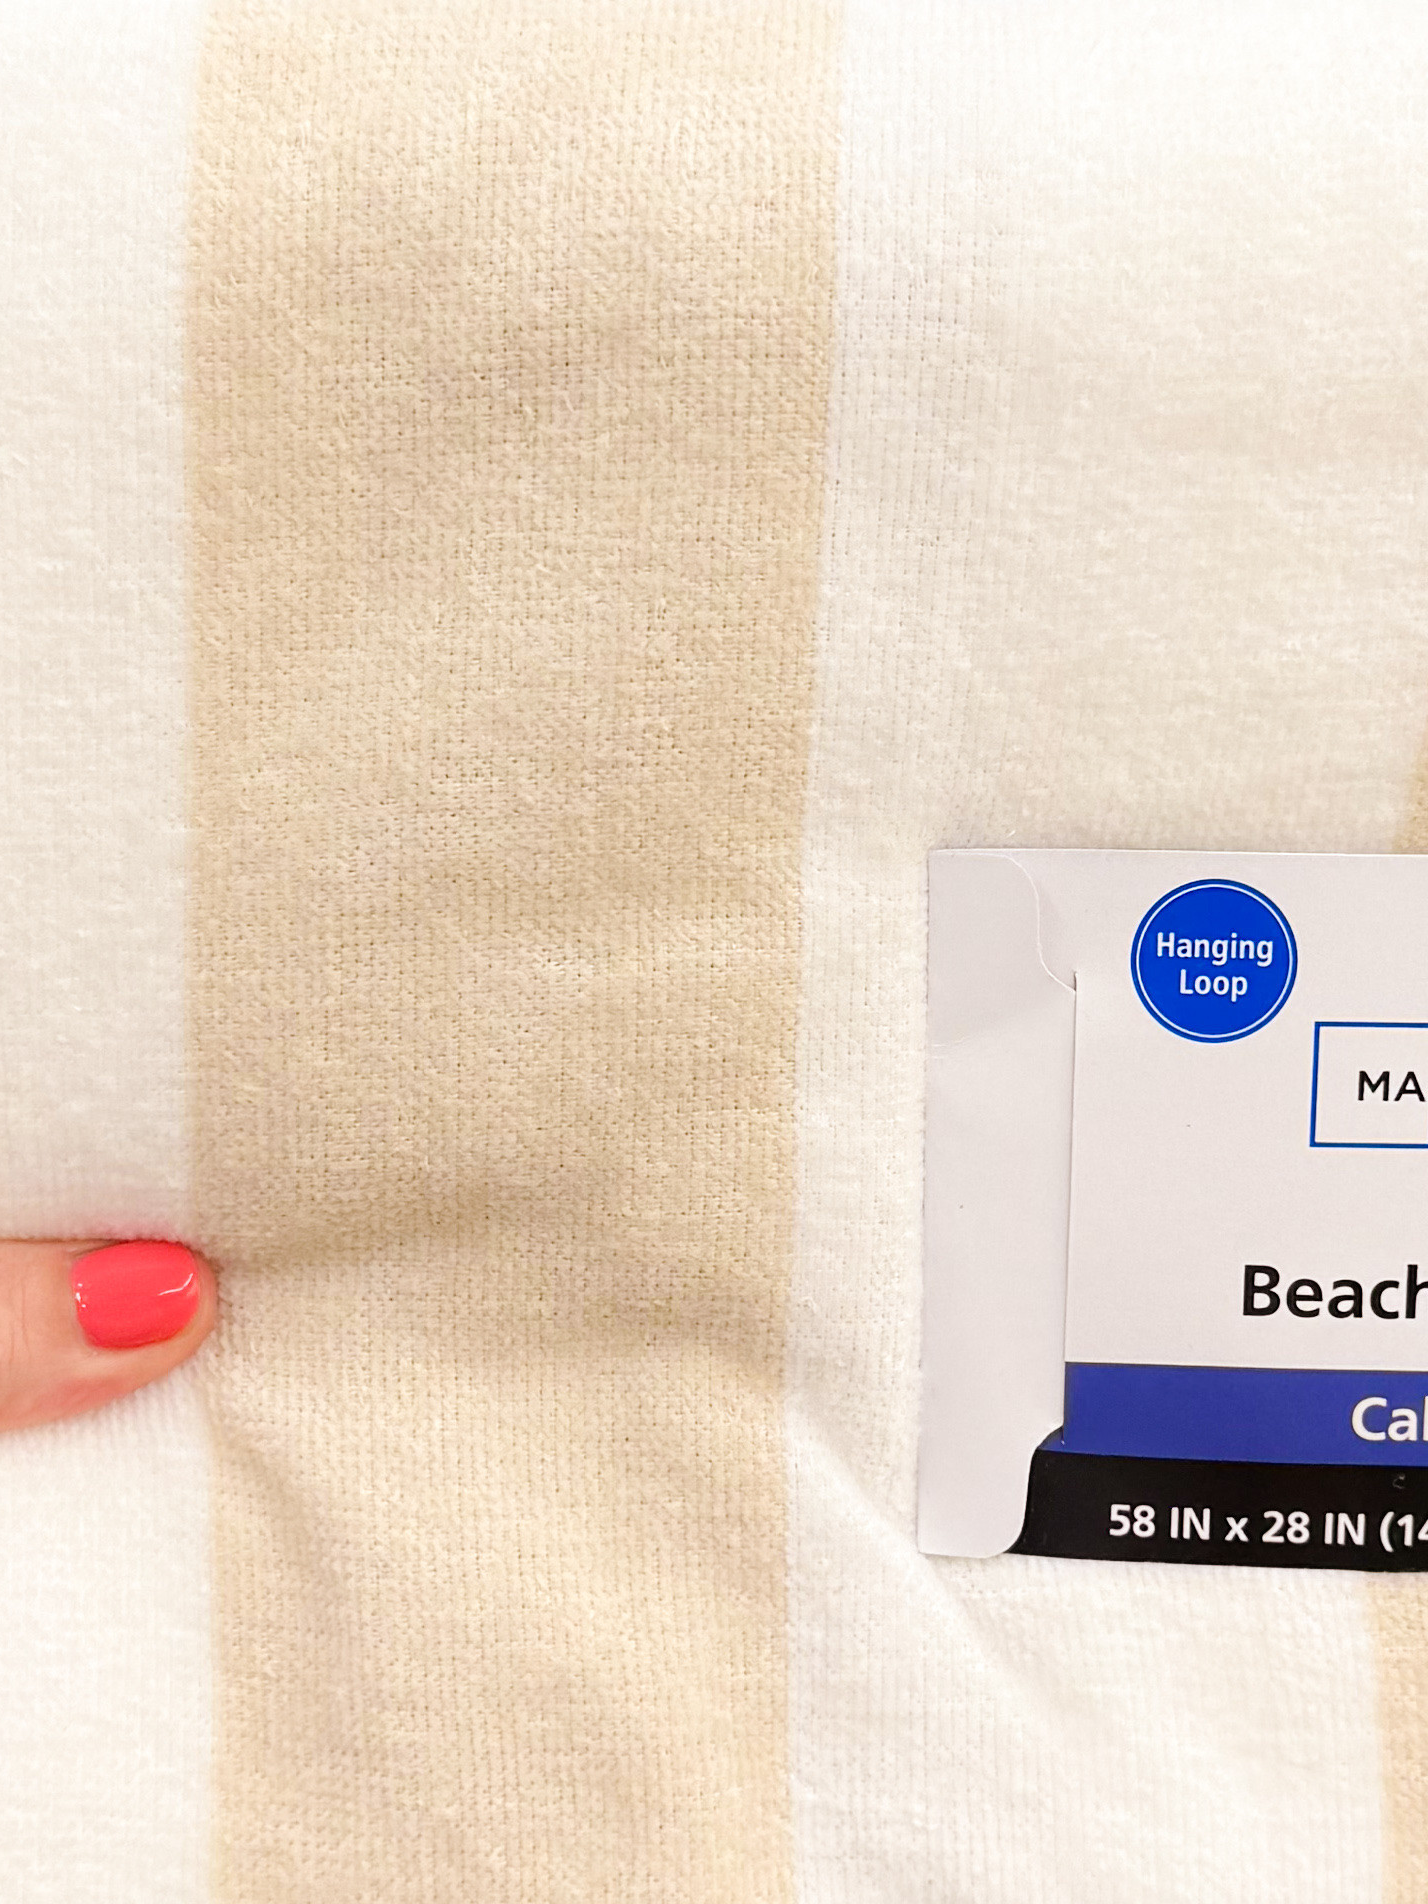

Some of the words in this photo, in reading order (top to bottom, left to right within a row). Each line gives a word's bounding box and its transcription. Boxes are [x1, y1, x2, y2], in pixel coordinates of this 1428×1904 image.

[1156, 932, 1274, 968] Hanging
[1179, 969, 1248, 1002] Loop
[1108, 1504, 1155, 1538] 58
[1170, 1507, 1212, 1541] IN
[1224, 1517, 1250, 1543] x
[1262, 1510, 1312, 1544] 28
[1324, 1511, 1367, 1546] IN
